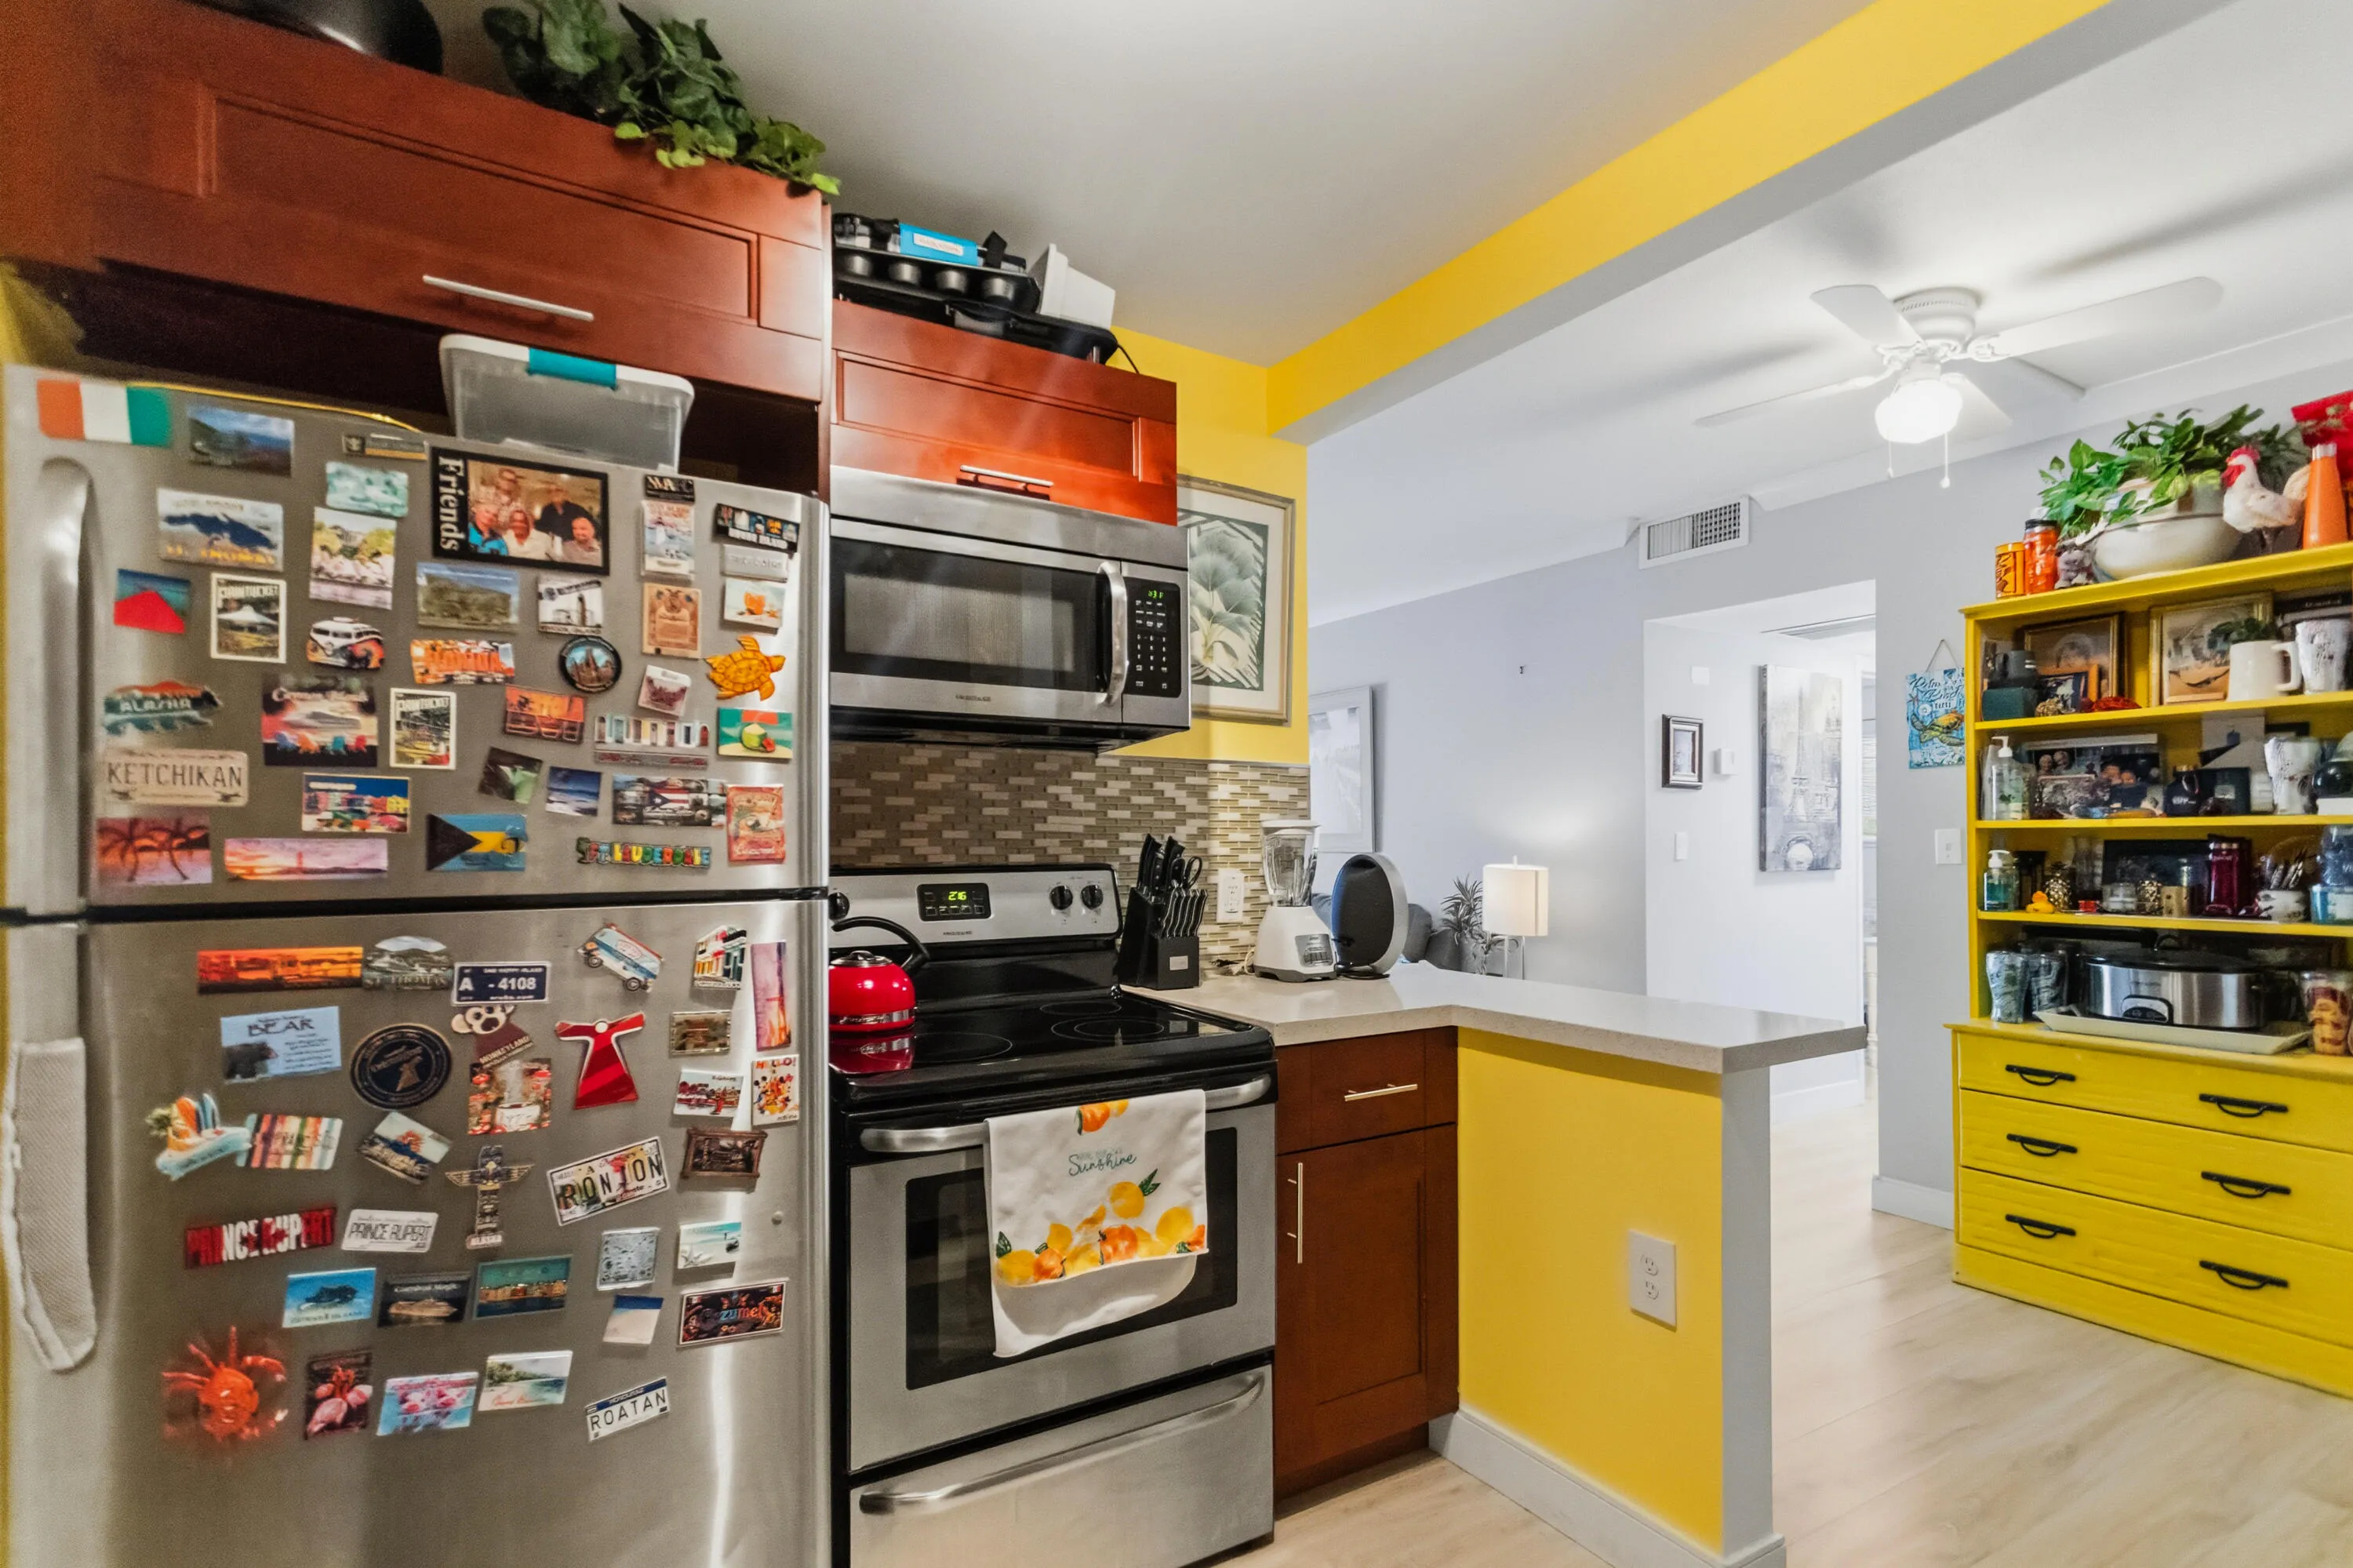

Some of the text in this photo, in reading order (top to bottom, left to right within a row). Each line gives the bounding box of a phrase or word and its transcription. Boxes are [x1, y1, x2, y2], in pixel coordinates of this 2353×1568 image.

[438, 457, 466, 551] Friends
[107, 762, 242, 788] KETCHIKAN
[612, 843, 711, 868] LAUDERDALE
[458, 977, 474, 991] A
[246, 1018, 315, 1037] BEAR
[1068, 1152, 1137, 1177] Sunshine
[349, 1222, 433, 1242] PRINCE RUPERT
[589, 1388, 667, 1432] ROATAN
